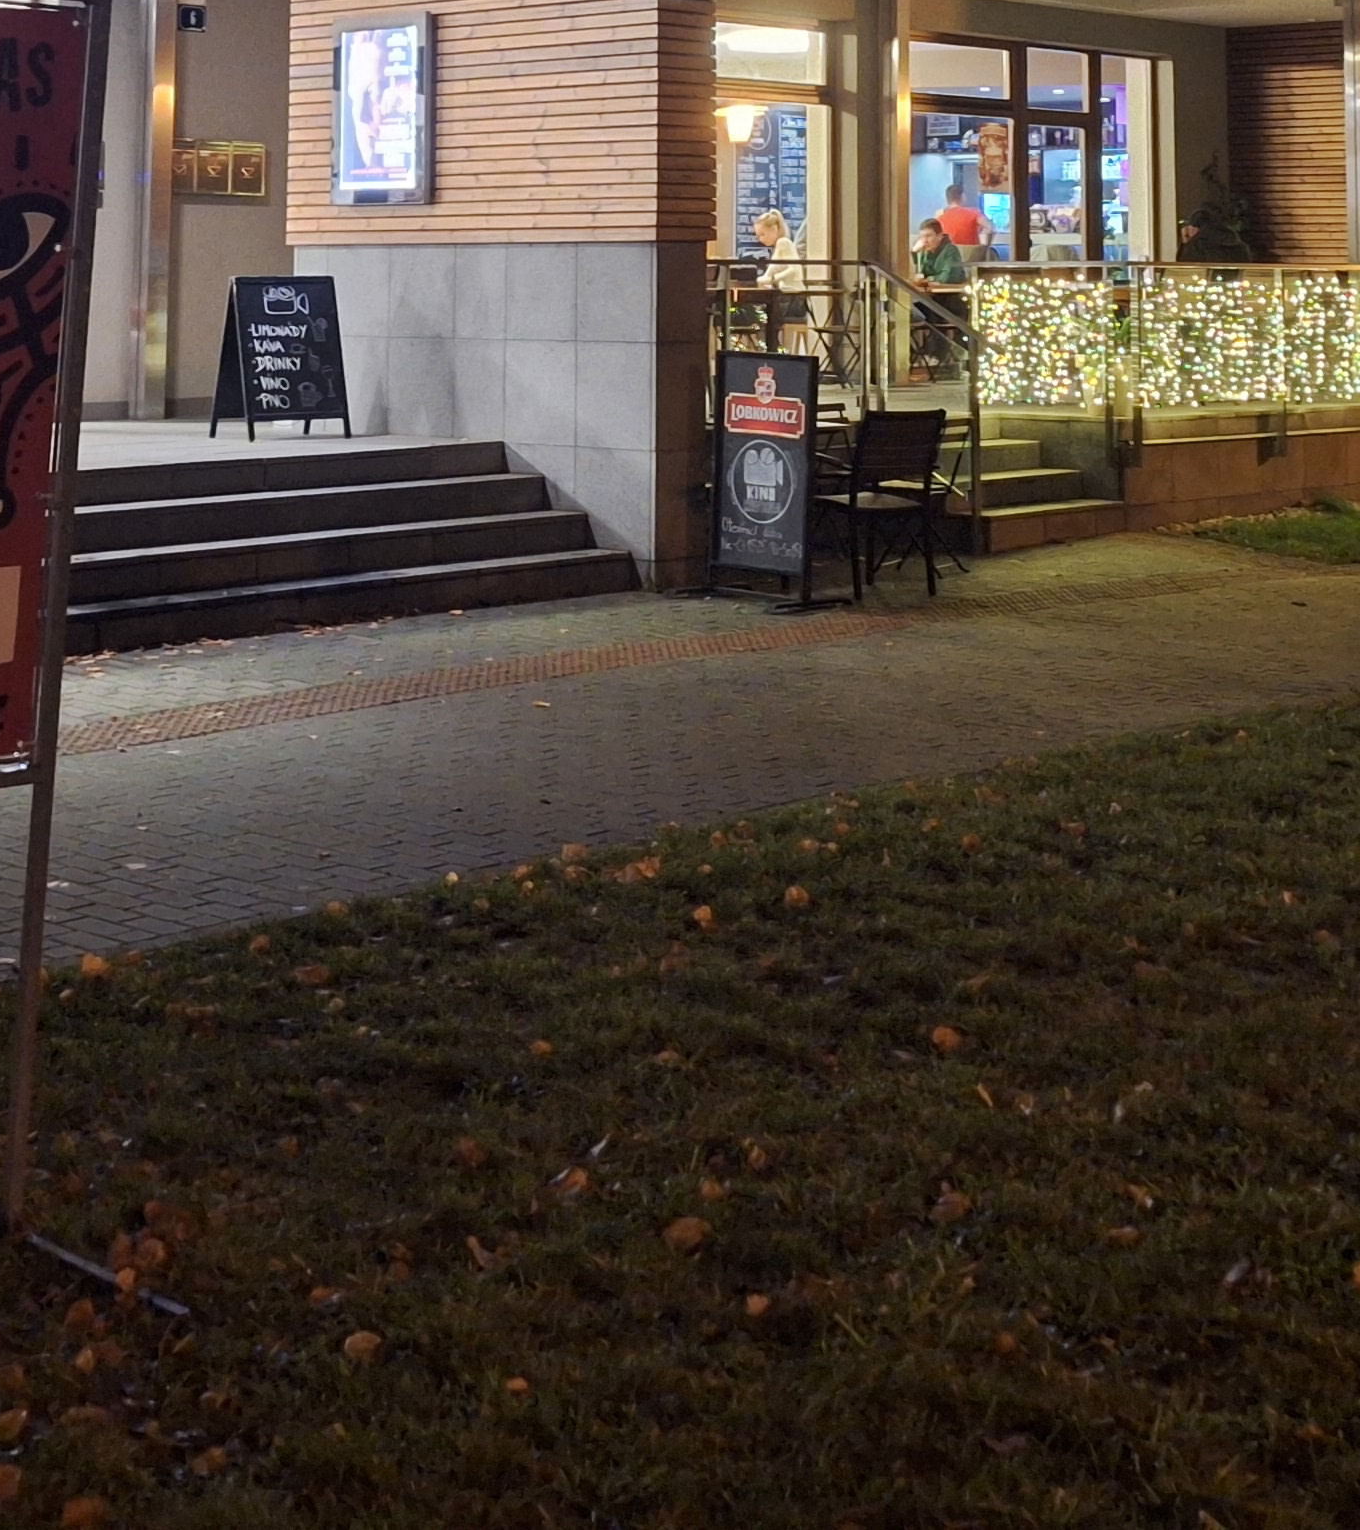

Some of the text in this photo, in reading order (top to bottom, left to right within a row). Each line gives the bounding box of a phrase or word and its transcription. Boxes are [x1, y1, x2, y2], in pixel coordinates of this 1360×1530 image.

[254, 355, 301, 372] DRINKY
[731, 403, 799, 424] LOBKOWICZ
[746, 485, 776, 502] KINO
